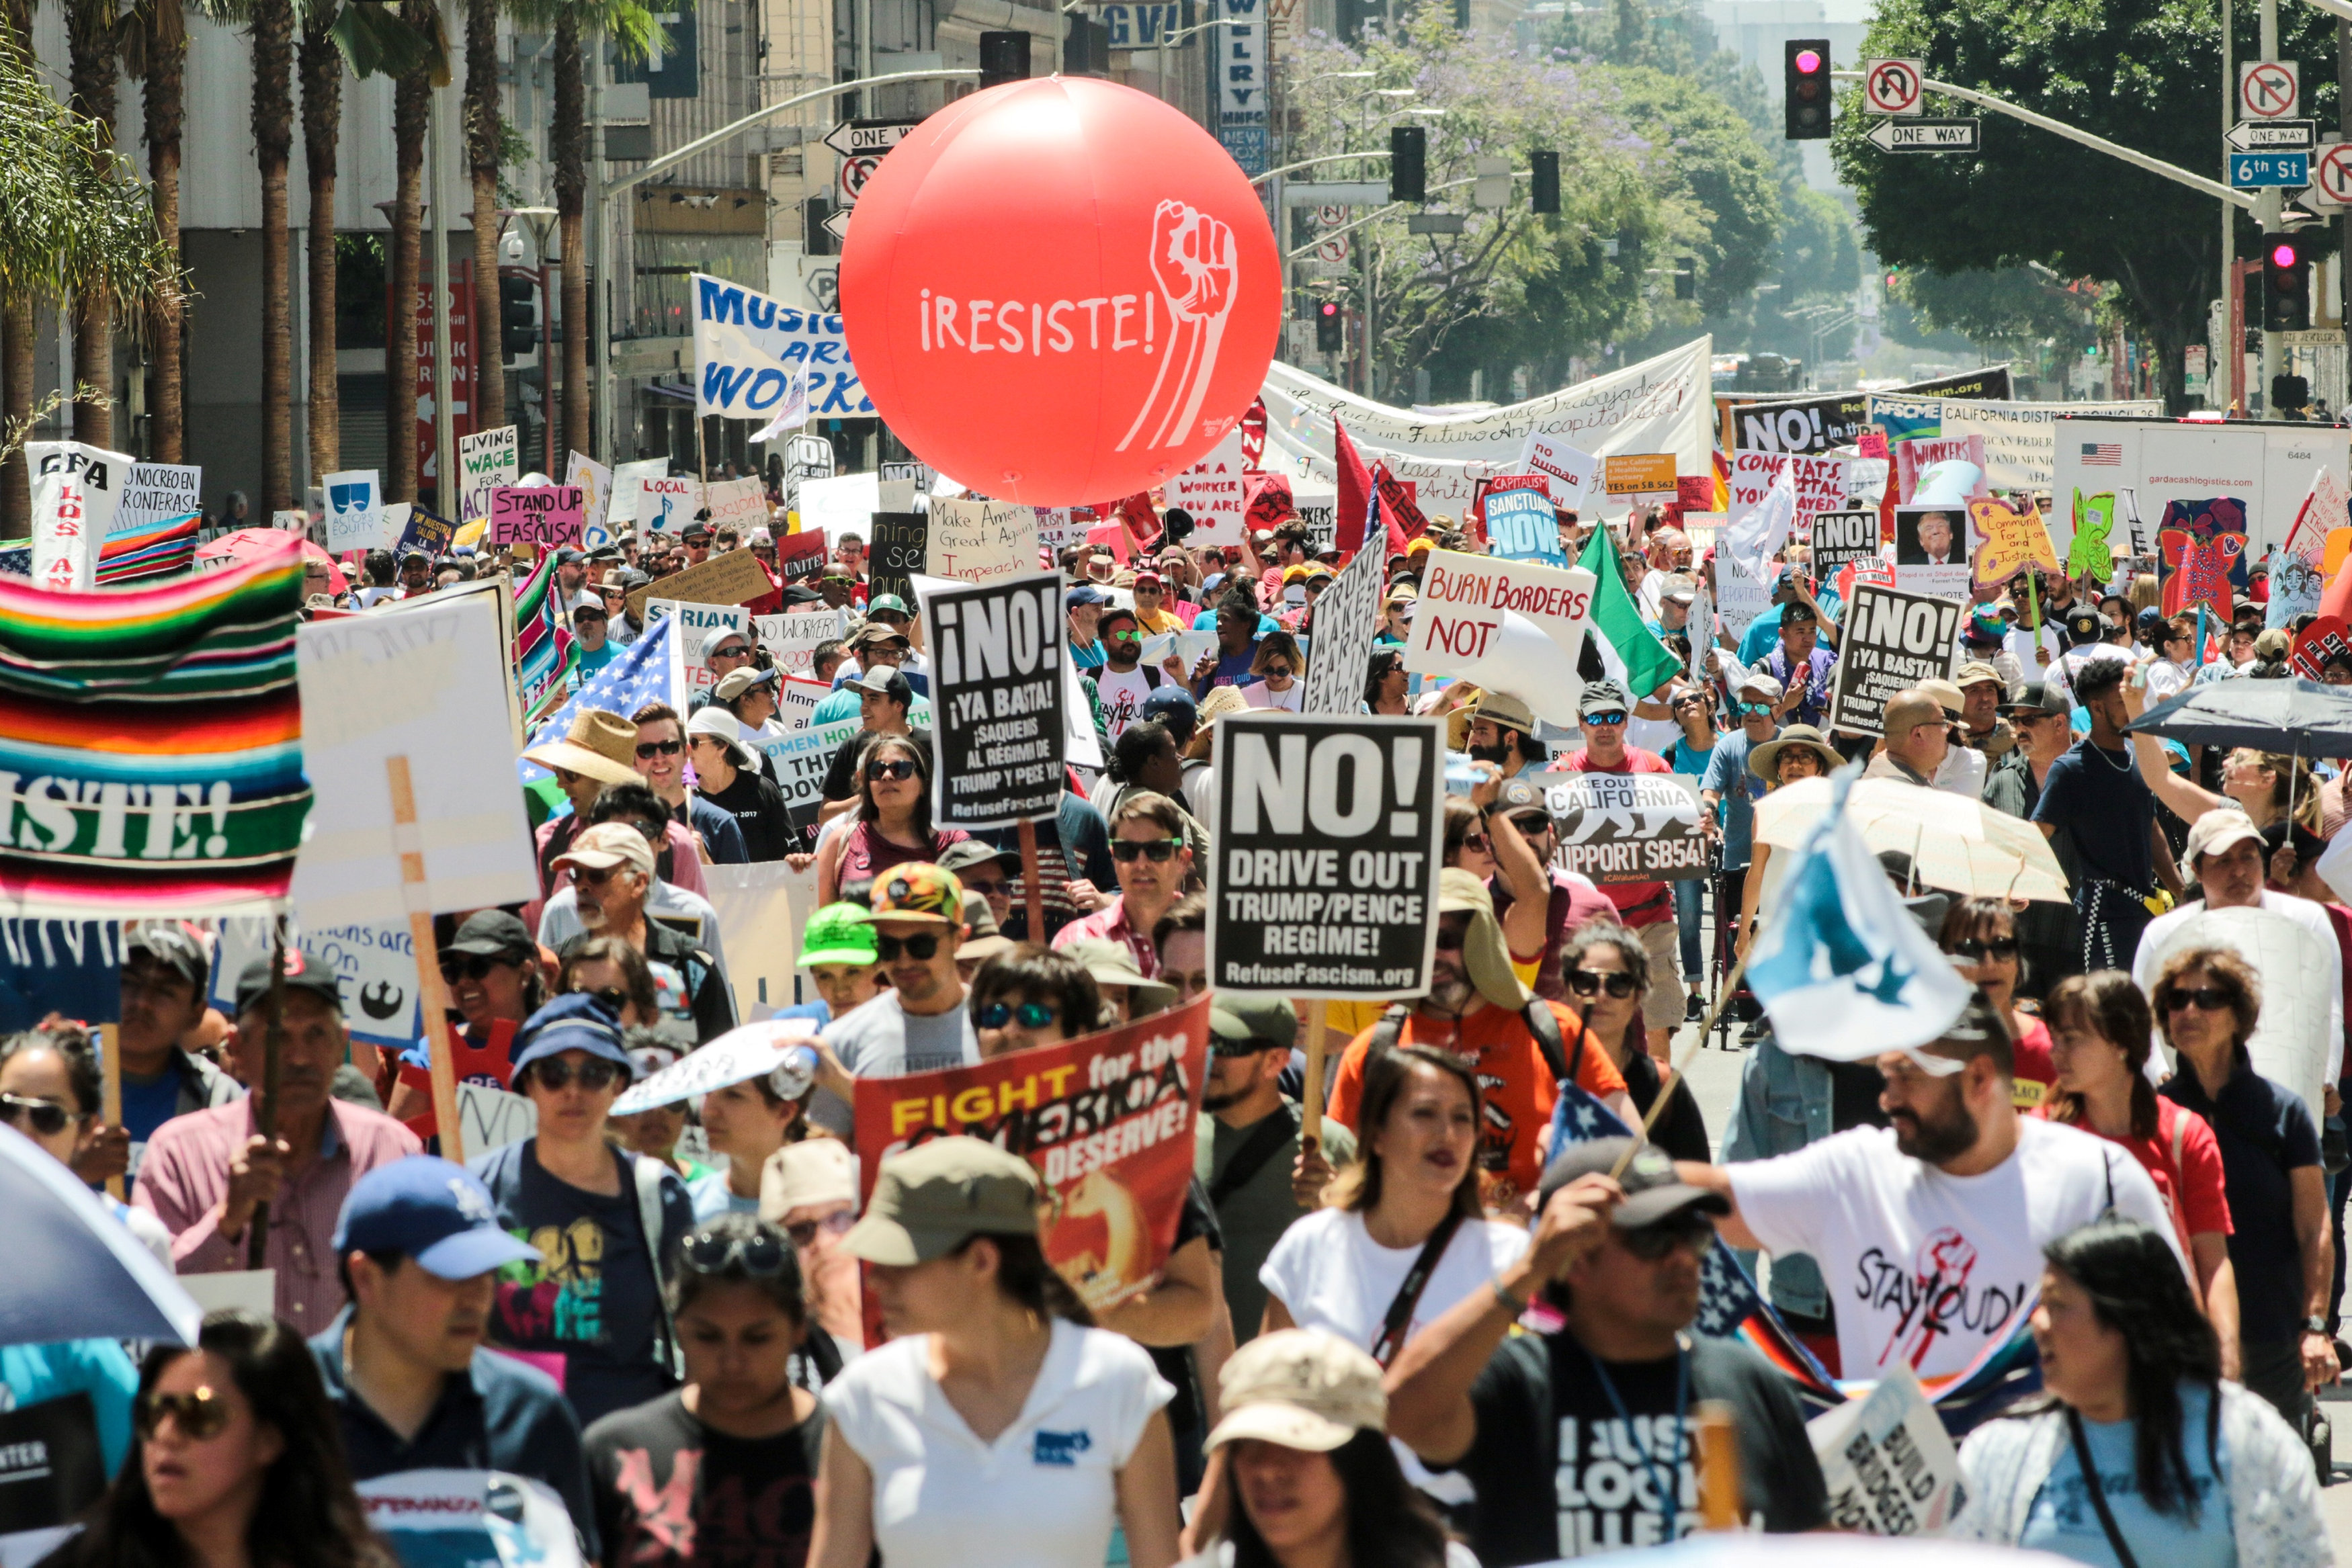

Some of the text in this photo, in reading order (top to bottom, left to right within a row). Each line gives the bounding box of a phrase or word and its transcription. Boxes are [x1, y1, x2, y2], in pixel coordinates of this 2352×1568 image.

[851, 129, 889, 146] ONE
[1224, 131, 1261, 144] NEW
[1892, 128, 1966, 142] ONE WAY
[2251, 130, 2304, 141] ONE WAY
[2238, 159, 2298, 181] 6th St
[920, 288, 1154, 356] ¡RESISTE!
[1873, 401, 1941, 419] AFSCME
[1946, 408, 2017, 422] CALIFORNIA
[1409, 426, 1489, 443] Futuro
[1745, 408, 1824, 451] NO!
[462, 429, 513, 453] LIVING
[1536, 443, 1552, 457] no
[464, 448, 515, 475] WAGE
[788, 438, 830, 470] NO!
[1608, 458, 1665, 468] Make California
[1912, 441, 1969, 467] WORKERS
[2287, 451, 2312, 460] 6484
[152, 468, 179, 488] CREO
[181, 472, 195, 490] EN
[1215, 463, 1227, 474] A
[1531, 455, 1579, 484] human
[1608, 474, 1644, 482] Sanctuary
[1614, 466, 1653, 474] Healthcare
[480, 474, 503, 488] FOR
[643, 479, 688, 494] LOCAL
[1179, 481, 1236, 493] WORKER
[1494, 477, 1548, 490] CAPITALISM
[1609, 482, 1624, 491] YES
[1627, 482, 1638, 490] on
[1657, 480, 1674, 488] 562
[2149, 474, 2253, 488] gardacashlogistics.com
[123, 489, 195, 513] RONTERAS!
[496, 489, 583, 514] STAND UP
[931, 495, 972, 529] Make
[1178, 500, 1241, 512] YOU ARE
[1489, 492, 1554, 519] SANCTUARY
[333, 522, 374, 536] EQUITY
[413, 512, 452, 535] POR NUESTRA
[497, 522, 582, 543] FASCISM
[1195, 517, 1216, 528] OO
[1816, 515, 1874, 548] ¡NO!
[1986, 515, 2040, 531] Communit
[418, 537, 427, 548] LA
[939, 522, 1033, 550] Great Again
[1490, 513, 1560, 557] NOW
[2001, 529, 2046, 540] For Love
[784, 553, 824, 576] UNITE!
[1819, 552, 1834, 565] ¡YA
[1855, 557, 1887, 571] STOP
[1995, 550, 2036, 562] Justice
[941, 554, 1024, 582] Impeach
[1872, 574, 1890, 582] MORE
[1427, 567, 1589, 620] BURN BORDERS
[648, 605, 738, 630] SRIAN
[1853, 591, 1956, 657] ¡NO!
[784, 618, 838, 640] WORKERS
[937, 586, 1058, 686] ¡NO!
[1425, 615, 1497, 658] NOT
[1852, 648, 1941, 679] ¡YA BASTA!
[1233, 673, 1251, 684] LOUD
[1855, 684, 1868, 697] AL
[949, 680, 1053, 730] ¡YA BASTA!
[1843, 695, 1878, 713] TRUMP
[966, 750, 984, 770] AL
[1037, 740, 1050, 759] DE
[951, 771, 1001, 795] TRUMP
[1004, 770, 1013, 788] Y
[1230, 732, 1423, 838] NO!
[1575, 779, 1665, 789] ICE OUT OF
[1551, 789, 1690, 811] CALIFORNIA
[740, 810, 757, 818] 2017
[1645, 838, 1707, 869] SB54!
[1228, 849, 1423, 889] DRIVE OUT
[1603, 873, 1650, 883] #CAValuesAct
[1226, 892, 1422, 924] TRUMP/PENCE
[1263, 924, 1380, 957] REGIME!
[1226, 961, 1414, 987] RefuseFascism.org
[892, 1064, 1077, 1136] FIGHT
[1089, 1053, 1135, 1088] for
[1140, 1033, 1189, 1070] the
[1045, 1100, 1188, 1186] DESERVE!
[1558, 1415, 1577, 1463] I
